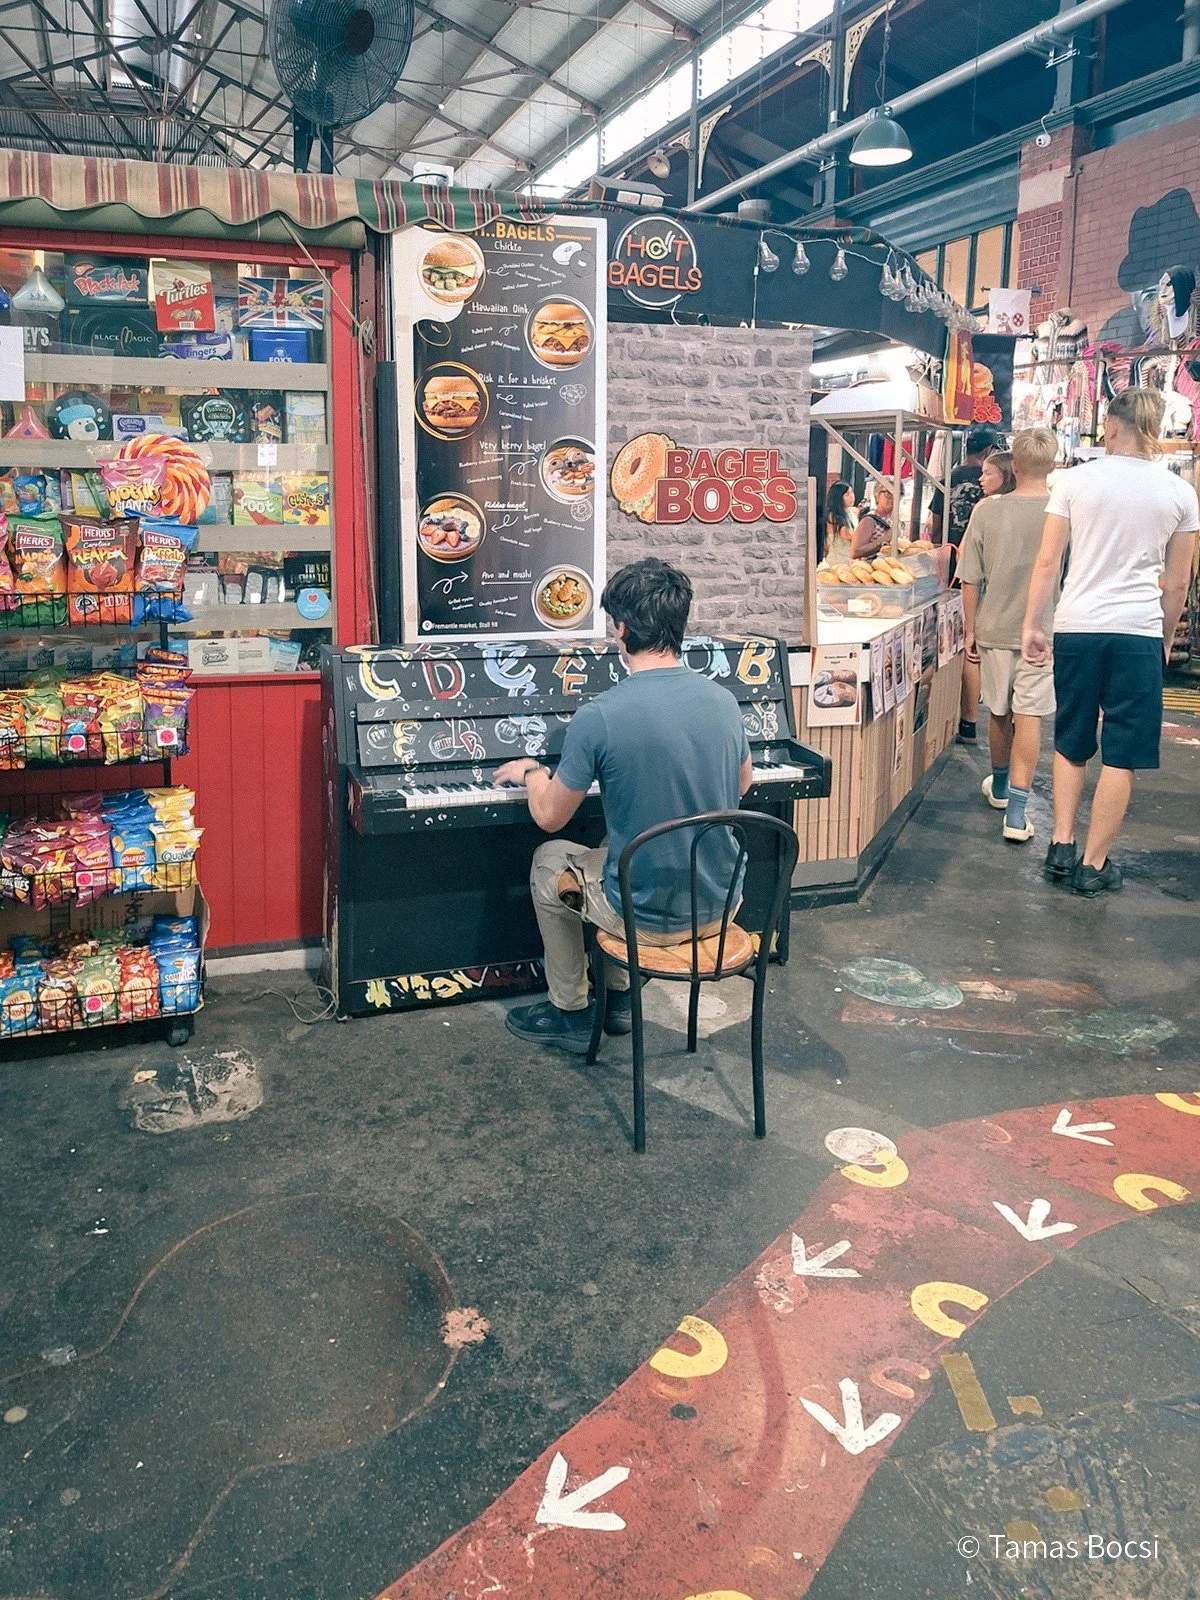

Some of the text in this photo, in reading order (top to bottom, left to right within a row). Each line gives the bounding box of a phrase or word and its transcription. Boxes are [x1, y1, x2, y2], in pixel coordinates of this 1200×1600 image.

[608, 261, 702, 291] BAGELS
[160, 283, 208, 306] Turtles
[472, 302, 529, 314] Hawaiian Oink
[94, 334, 120, 342] BLACK
[186, 347, 216, 358] fingers
[498, 374, 504, 383] it
[508, 373, 518, 384] for
[532, 374, 557, 385] brisket
[480, 440, 546, 452] Very berry bagel
[666, 448, 789, 480] BAGEL
[116, 500, 153, 512] GIANTS
[655, 477, 798, 523] BOSS
[84, 528, 112, 538] HERR'S
[19, 537, 50, 547] HERR'S
[148, 534, 176, 546] HERR'S
[498, 570, 510, 578] and
[35, 717, 60, 729] WALKERS
[86, 854, 110, 866] WALKERS
[121, 854, 146, 864] WALKERS
